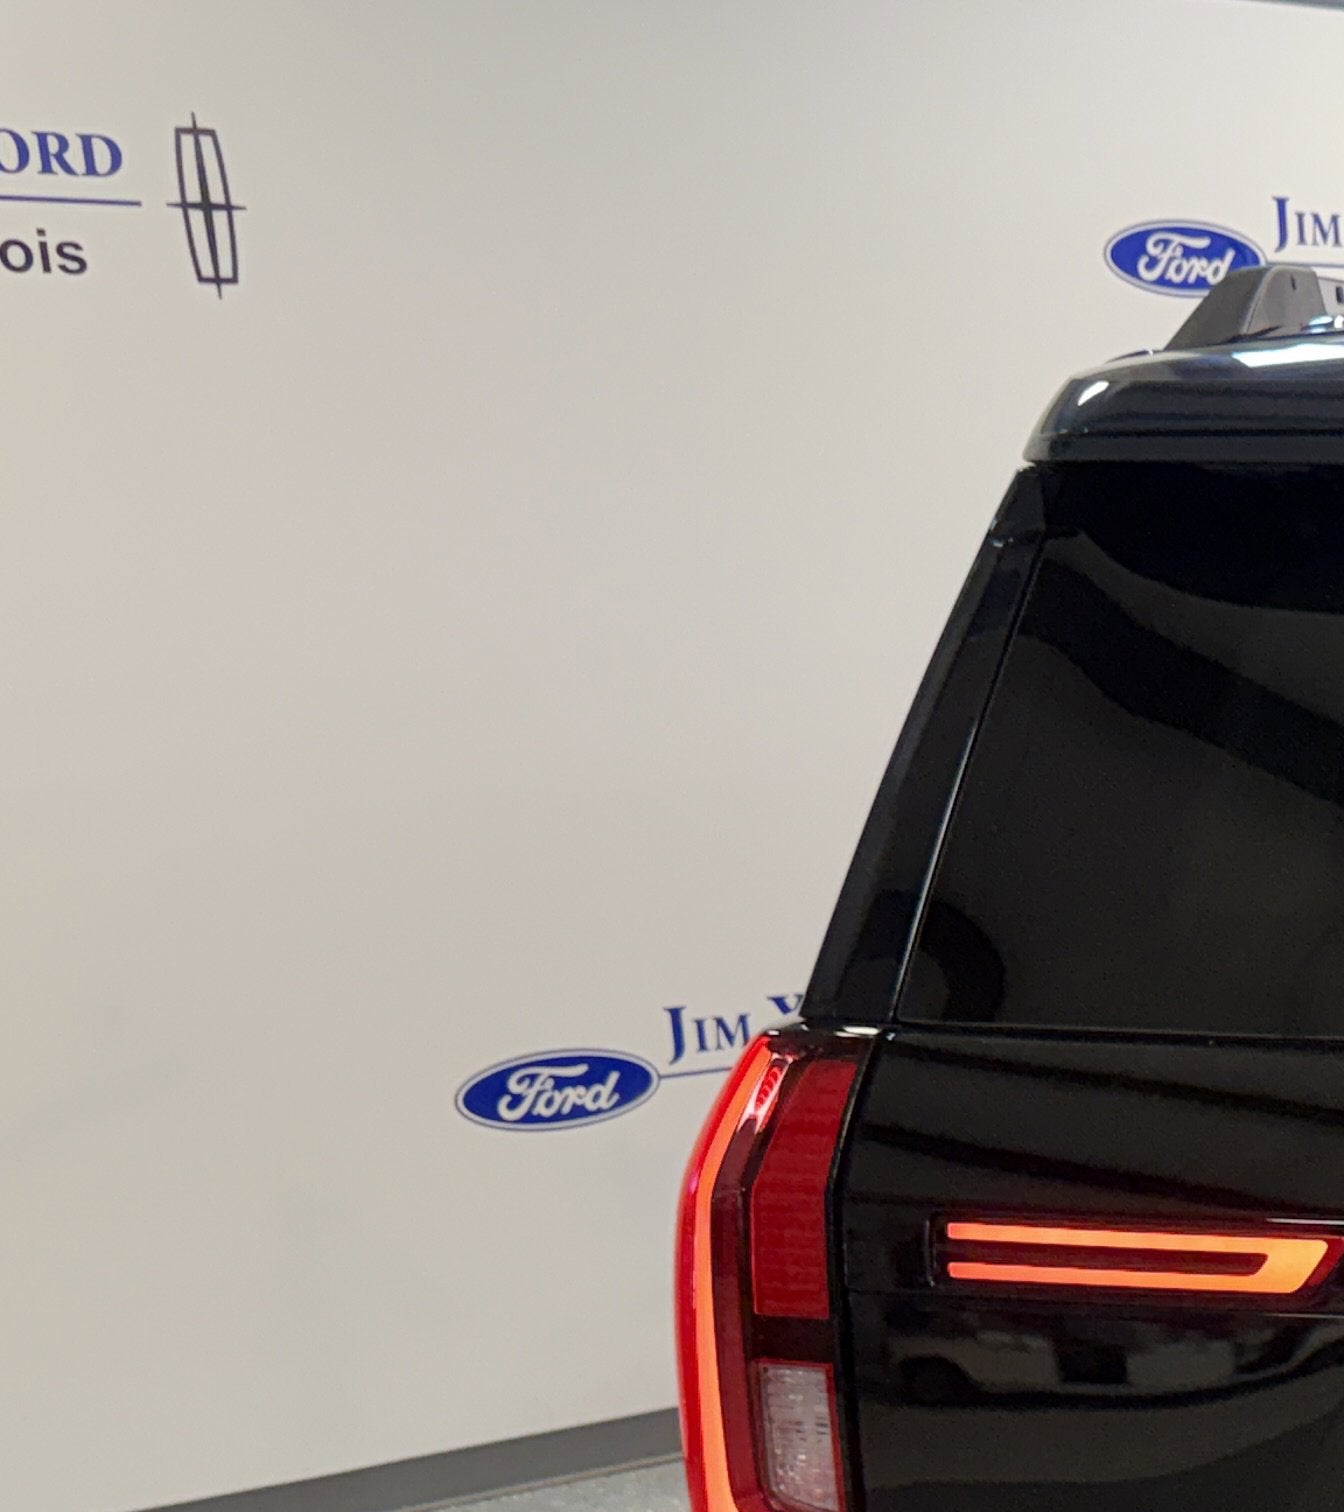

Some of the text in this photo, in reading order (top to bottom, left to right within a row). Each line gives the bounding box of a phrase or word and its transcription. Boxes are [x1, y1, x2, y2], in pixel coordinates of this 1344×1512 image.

[0, 127, 123, 178] ORD
[1273, 196, 1342, 252] JIM
[1137, 231, 1236, 286] Ford
[663, 1006, 750, 1065] JIM
[496, 1063, 620, 1121] Ford
